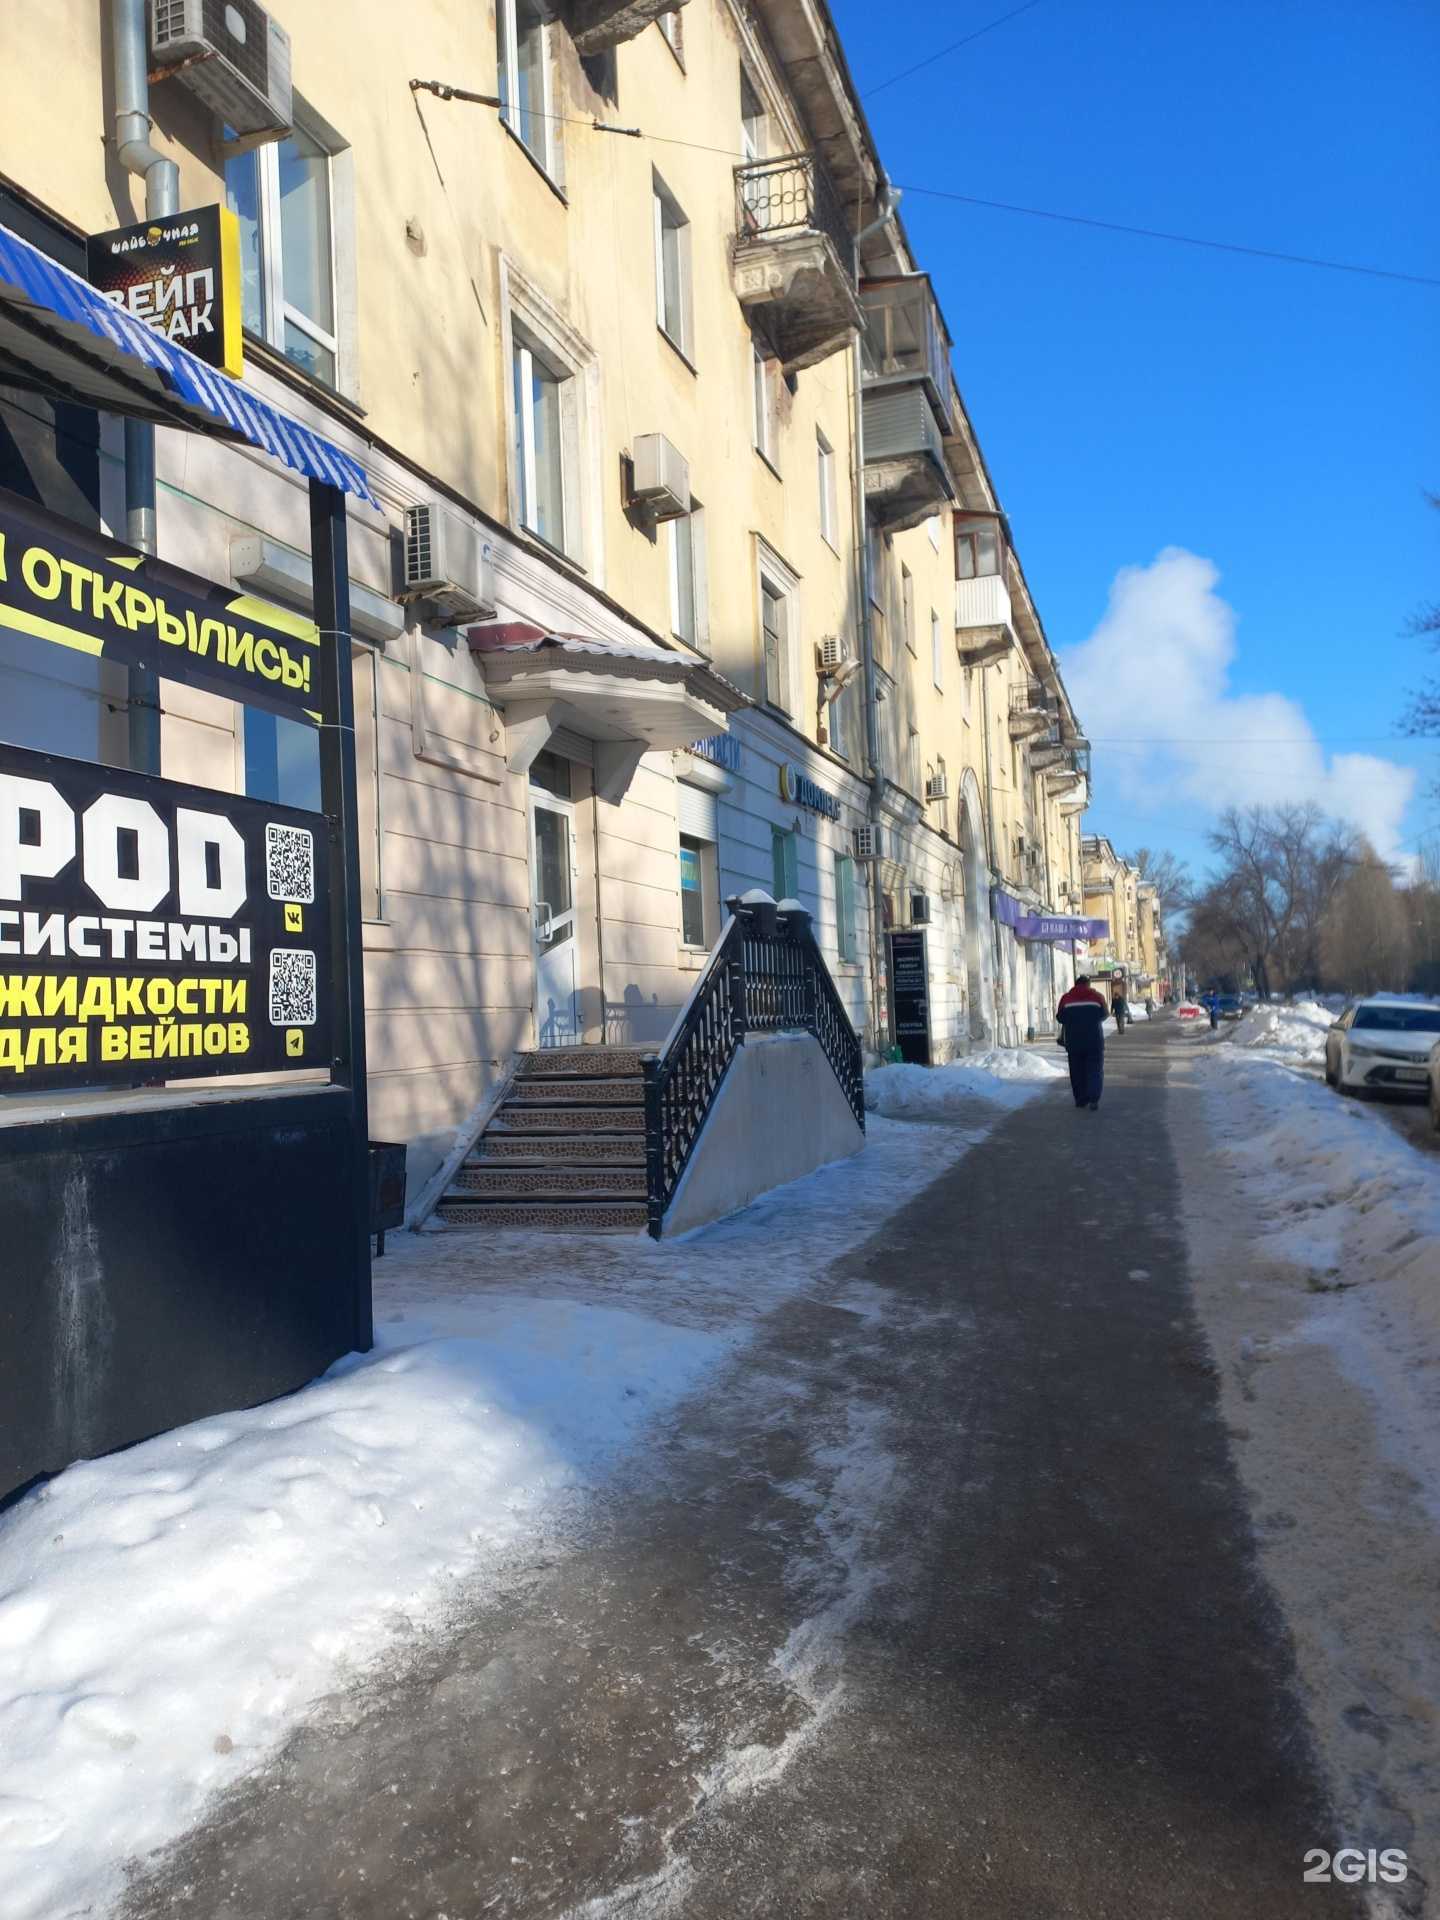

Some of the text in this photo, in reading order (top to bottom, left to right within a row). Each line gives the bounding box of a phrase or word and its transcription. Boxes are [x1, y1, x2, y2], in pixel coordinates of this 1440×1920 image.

[21, 546, 311, 693] ОТКРЫЛИСЬ!
[0, 773, 247, 919] POD
[0, 910, 251, 963] СИСТЕМЫ
[0, 975, 247, 1023] ЖИДКОСТИ
[0, 1016, 250, 1073] ДЛЯ ВЕЙПОВ
